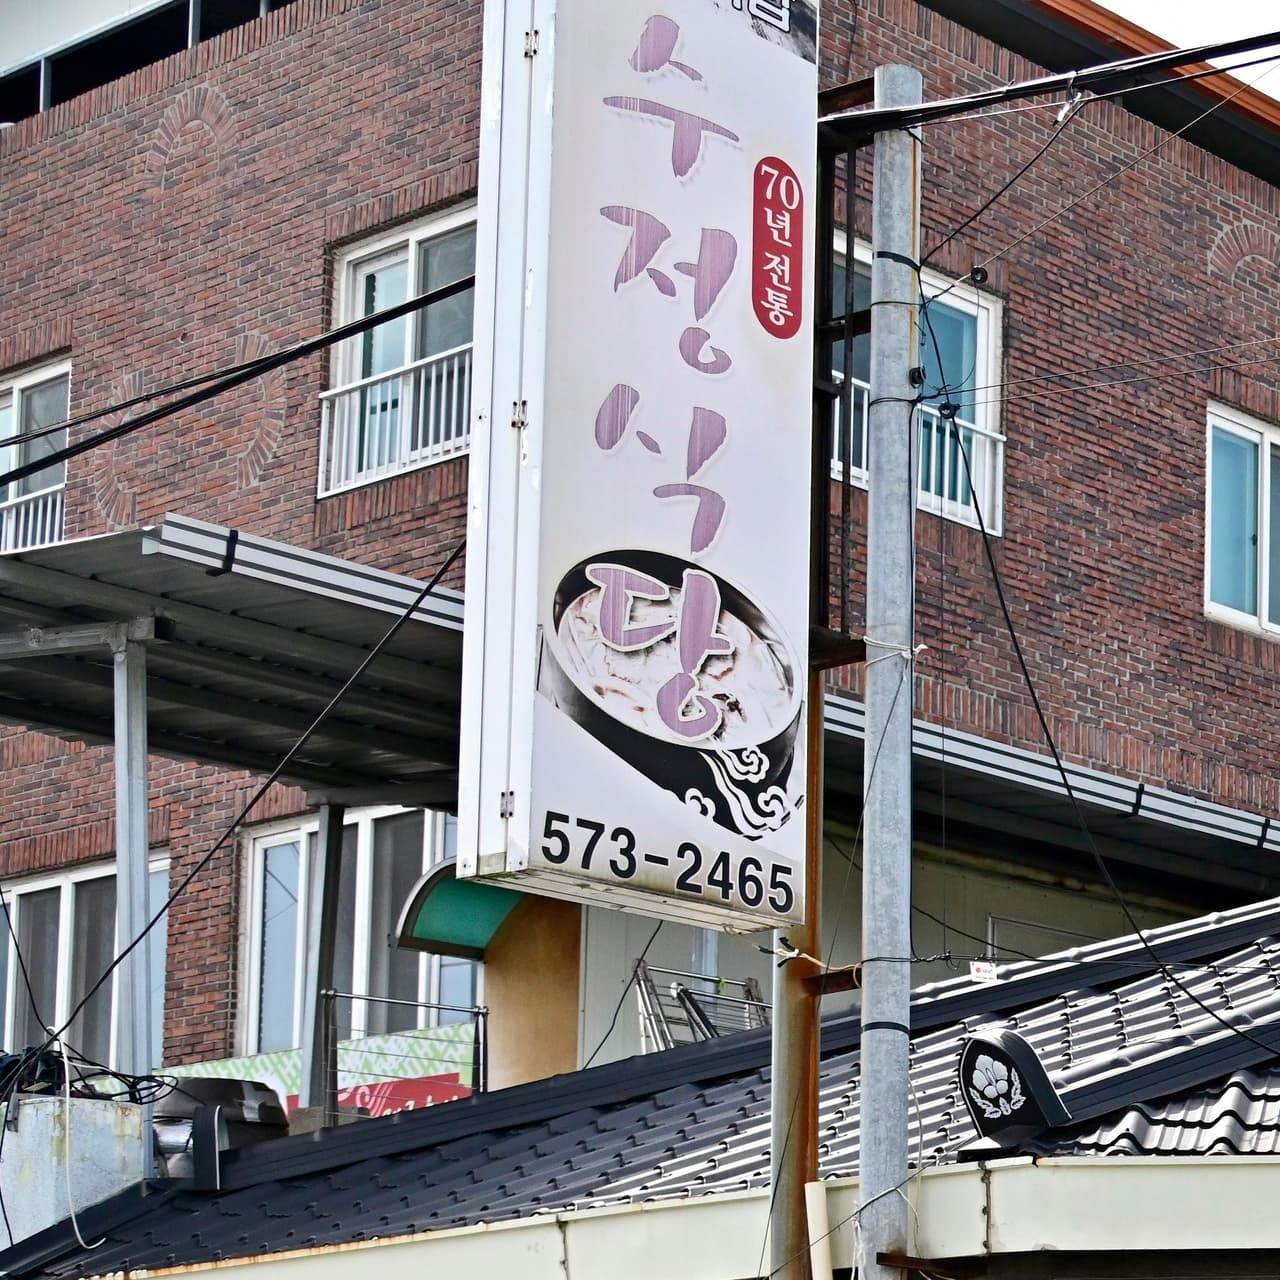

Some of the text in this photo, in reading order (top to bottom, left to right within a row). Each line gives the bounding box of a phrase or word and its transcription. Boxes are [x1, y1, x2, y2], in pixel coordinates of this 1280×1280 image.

[759, 164, 801, 326] 70년 전통
[586, 14, 741, 740] 수정식당
[541, 810, 794, 914] 573-2465
